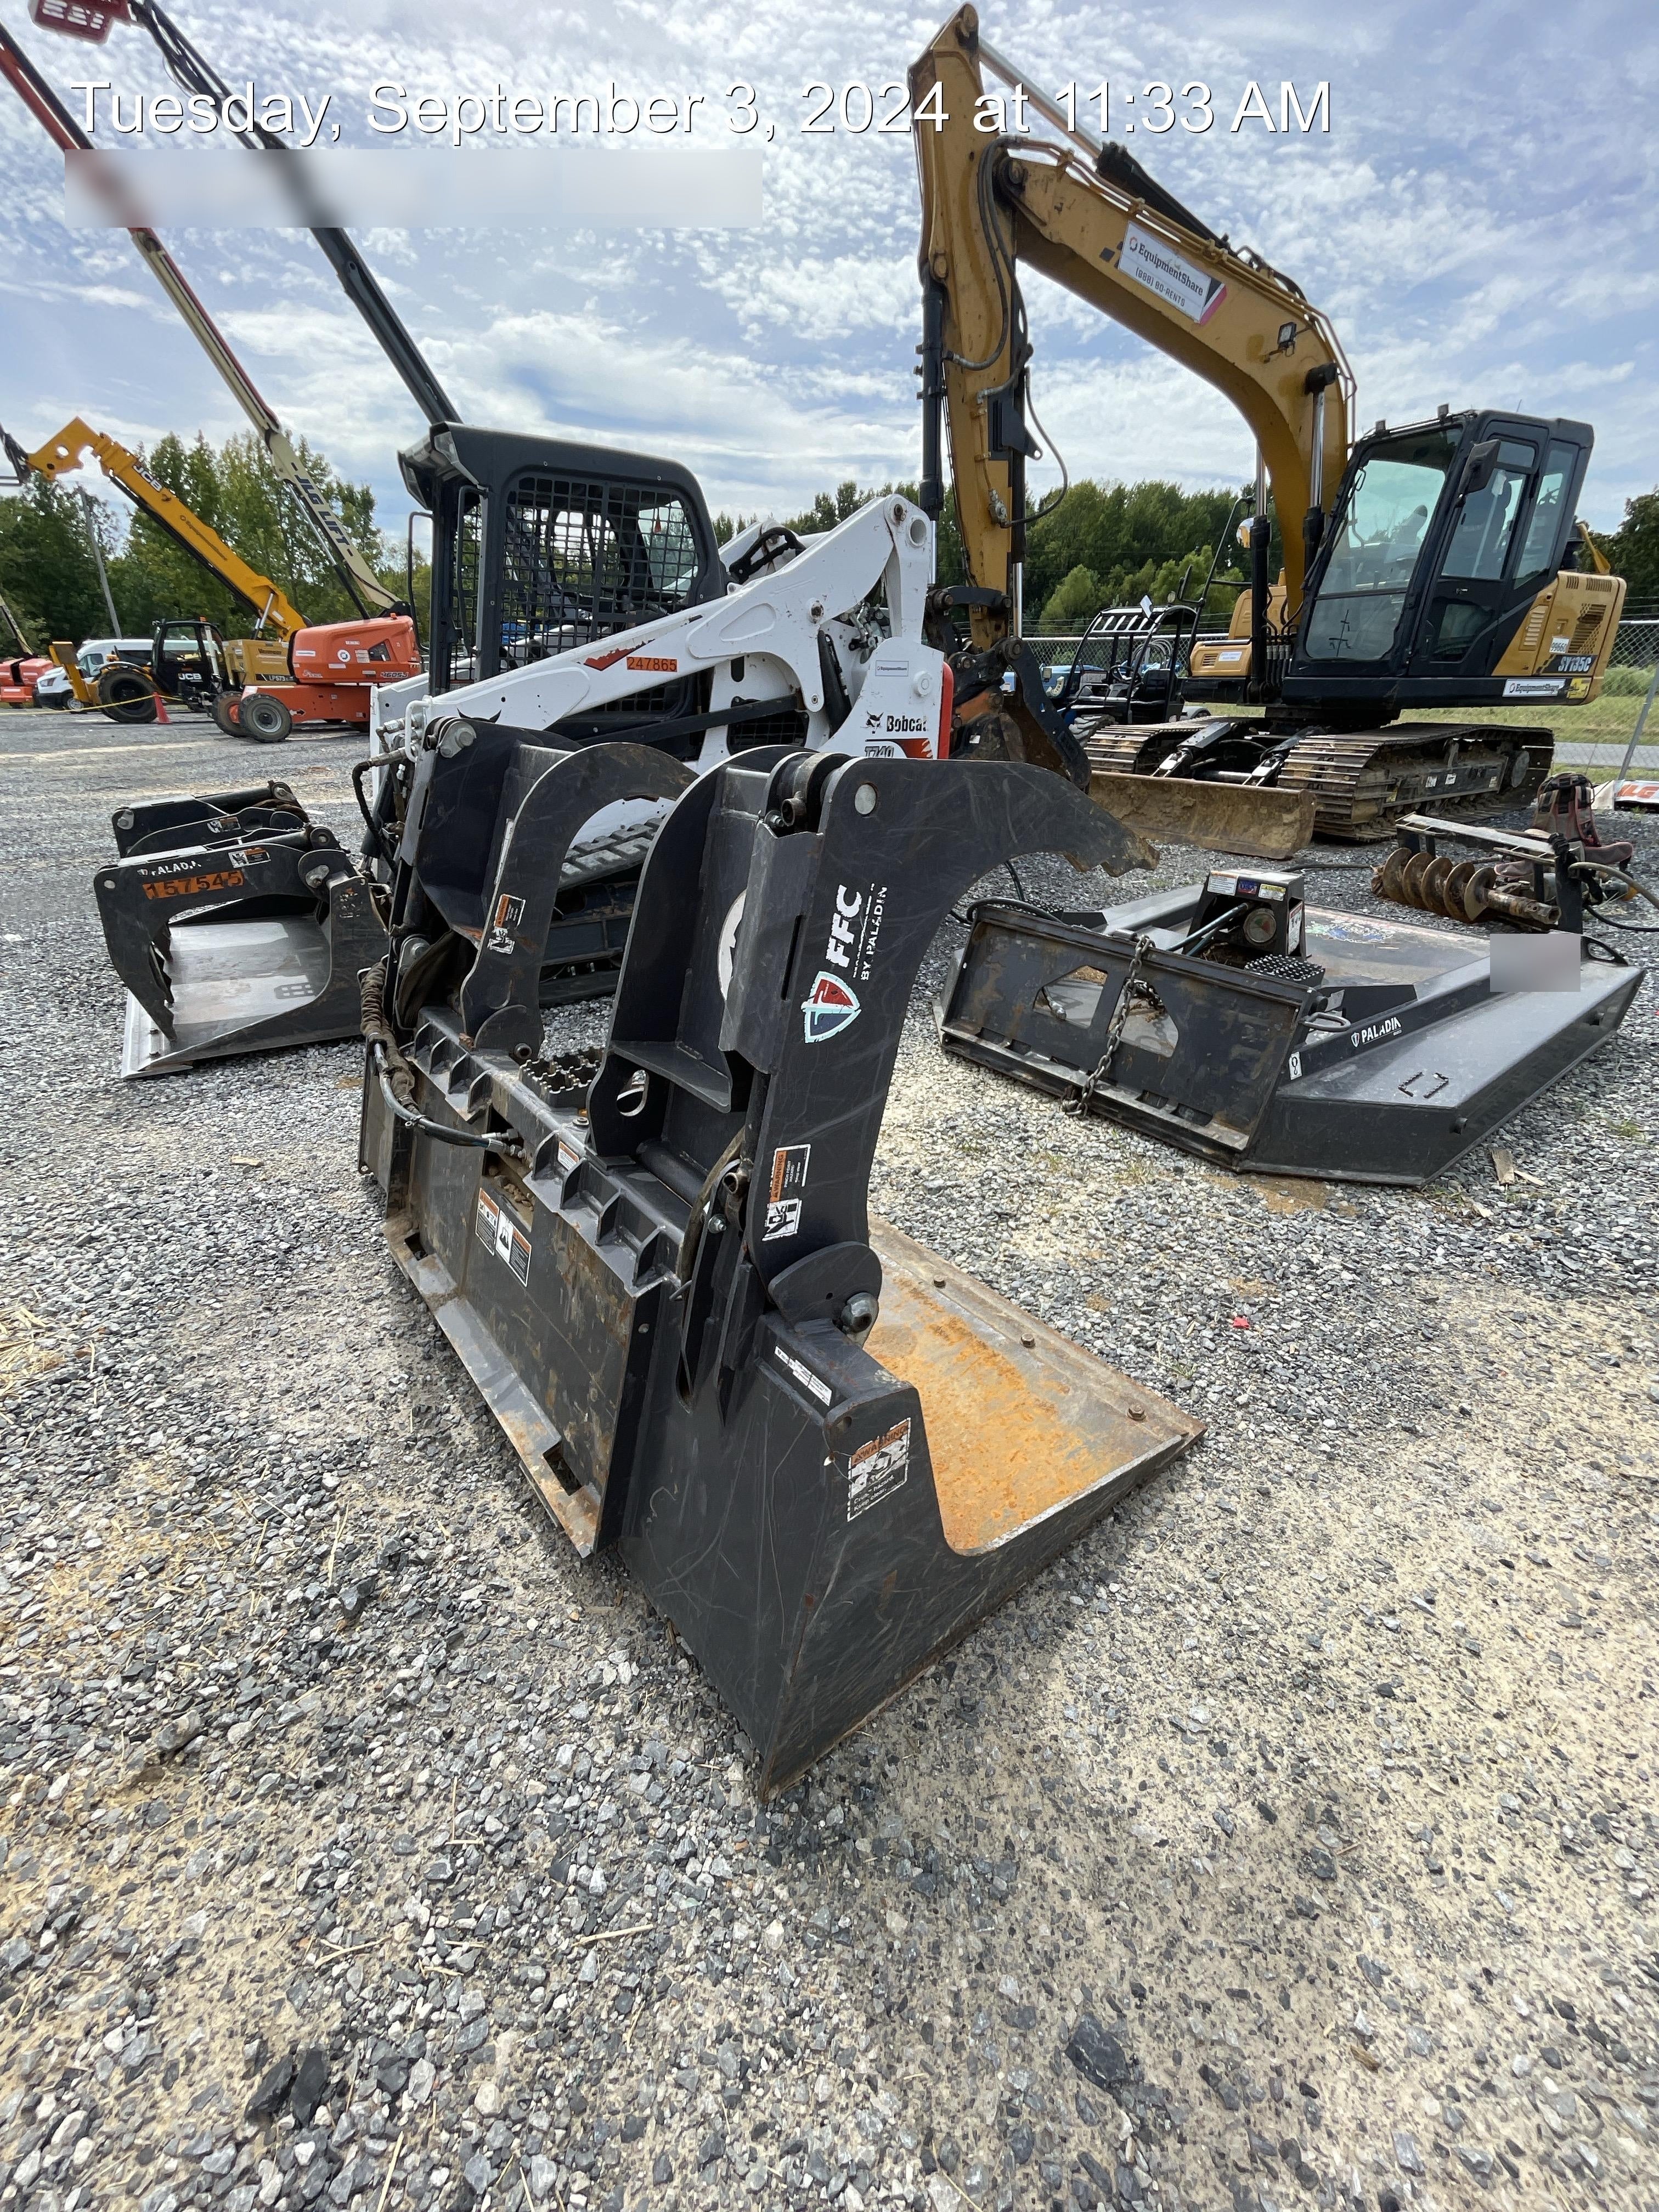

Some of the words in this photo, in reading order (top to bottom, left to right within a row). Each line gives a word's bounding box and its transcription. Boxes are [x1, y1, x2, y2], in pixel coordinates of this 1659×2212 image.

[1138, 242, 1204, 296] EquipmentShare
[133, 465, 162, 492] JCB
[294, 475, 324, 505] JLG
[318, 511, 351, 545] LIFT
[627, 657, 677, 672] 247865
[1558, 656, 1592, 672] SY135C
[886, 715, 928, 732] Bobcat
[826, 884, 862, 968] FFC
[860, 961, 871, 981] BY
[866, 886, 888, 955] PALADIN
[773, 1154, 783, 1191] WARNING
[860, 1426, 909, 1457] WANING
